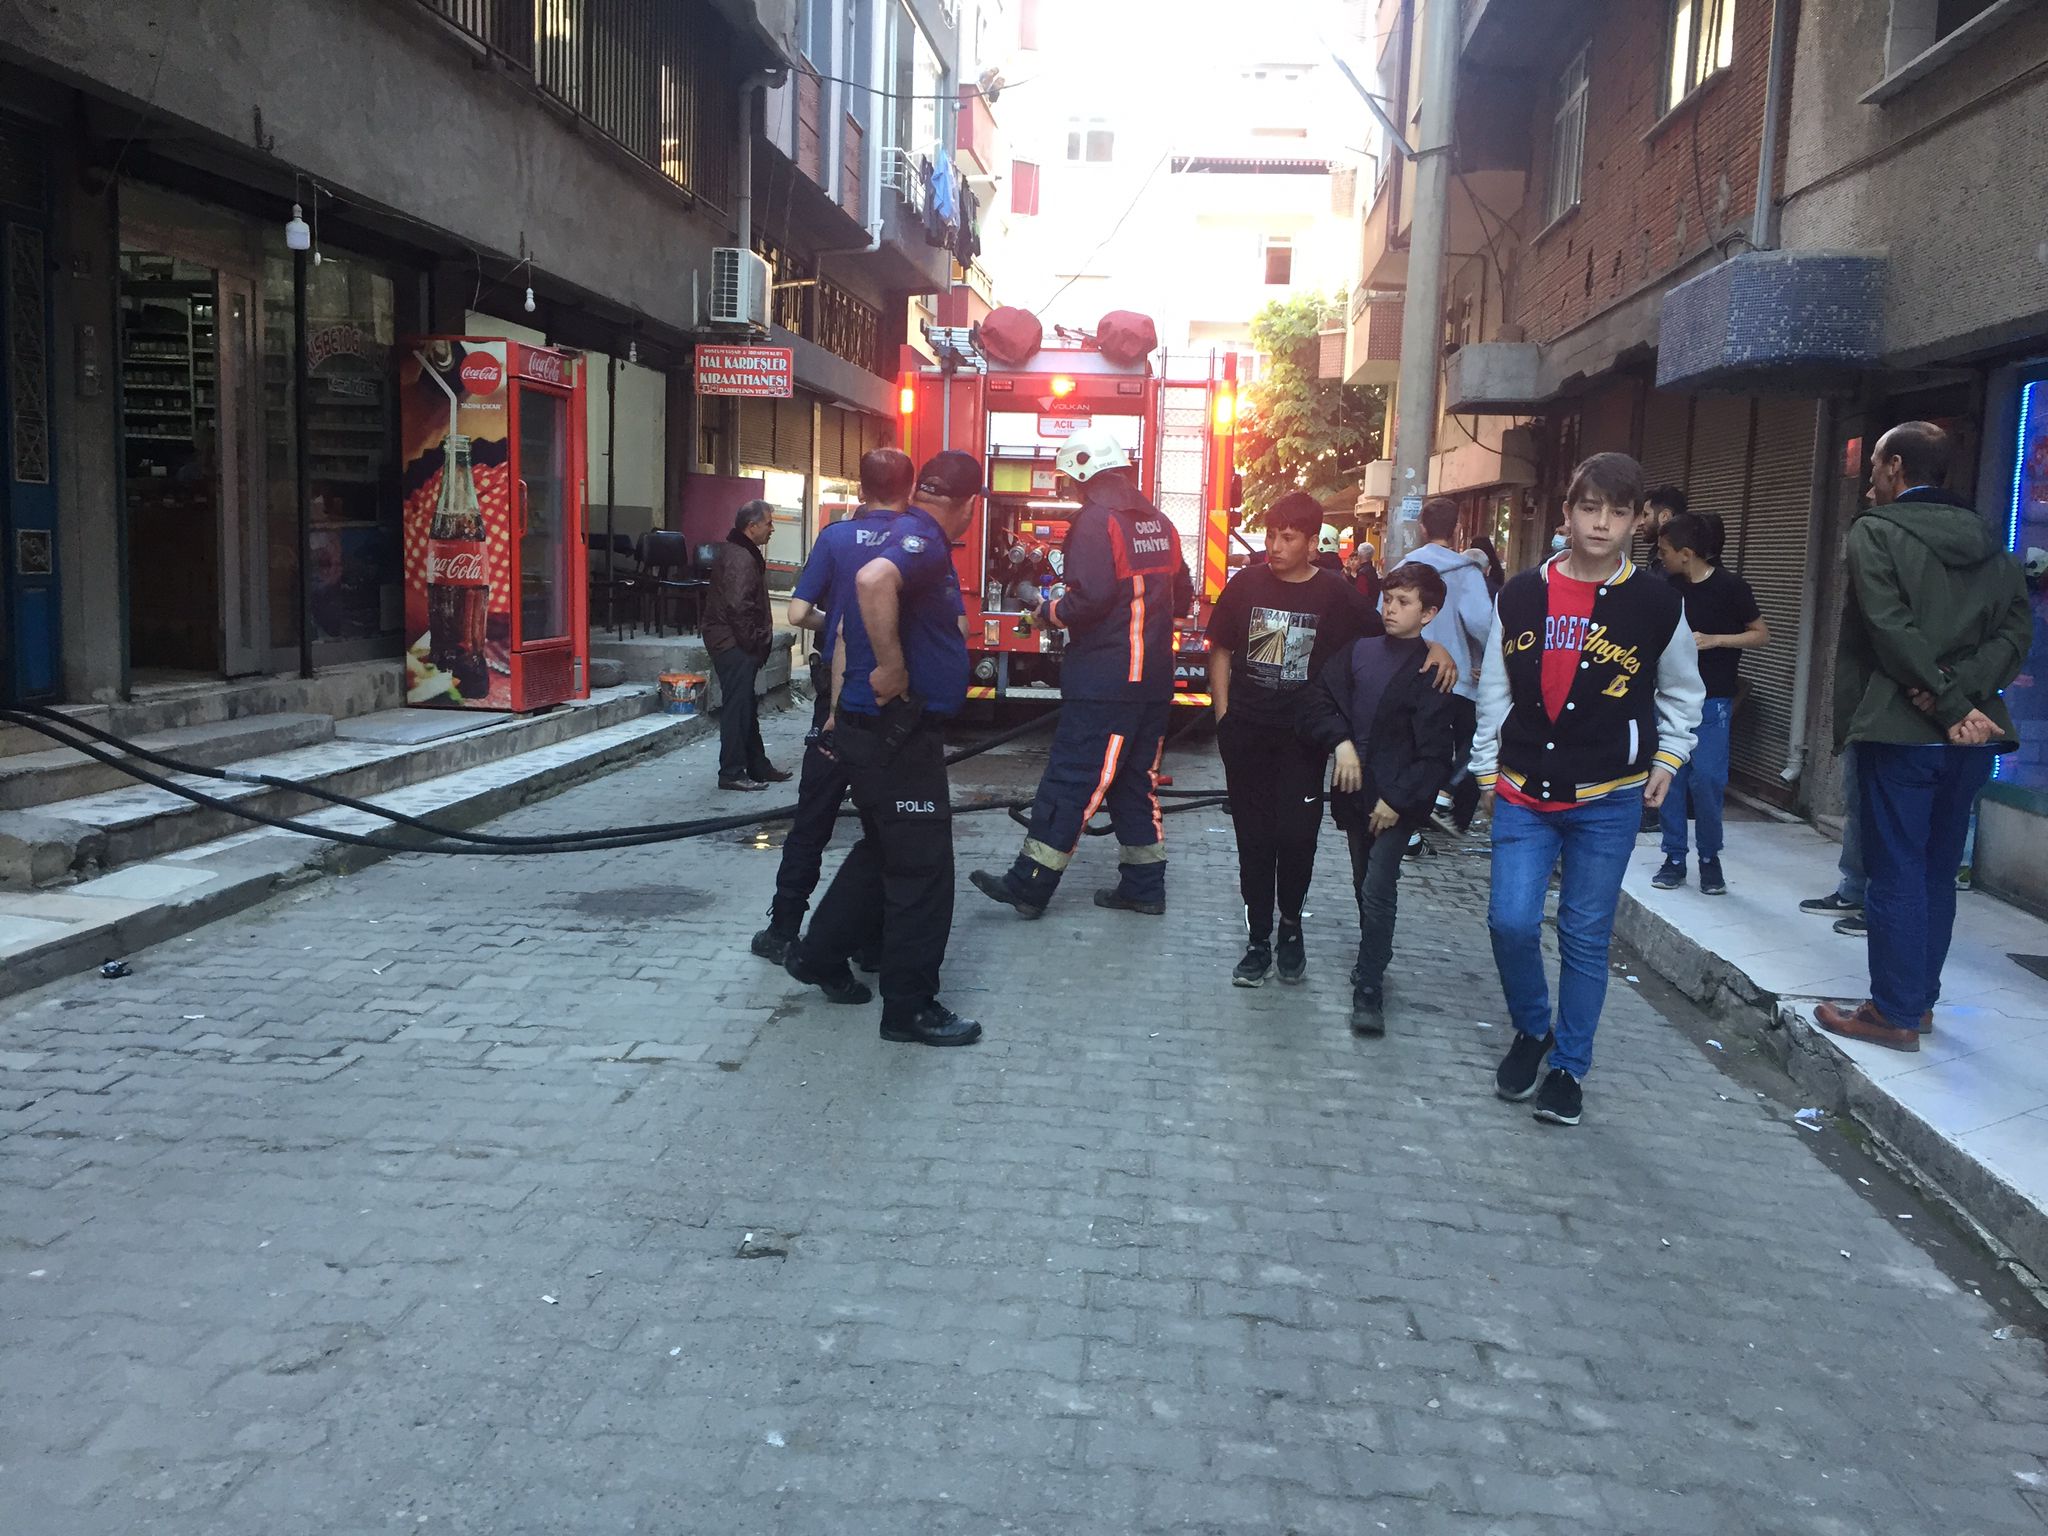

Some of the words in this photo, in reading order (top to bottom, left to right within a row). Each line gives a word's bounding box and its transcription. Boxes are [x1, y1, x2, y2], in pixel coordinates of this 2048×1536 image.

[700, 355, 722, 369] HAL
[724, 356, 787, 374] KARDEŞLER
[461, 366, 499, 380] Coca-Cola
[699, 372, 788, 387] KIRAATHANESİ
[1052, 403, 1090, 411] VOLKAN
[1135, 520, 1162, 535] ORDU
[1582, 625, 1642, 675] Angeles
